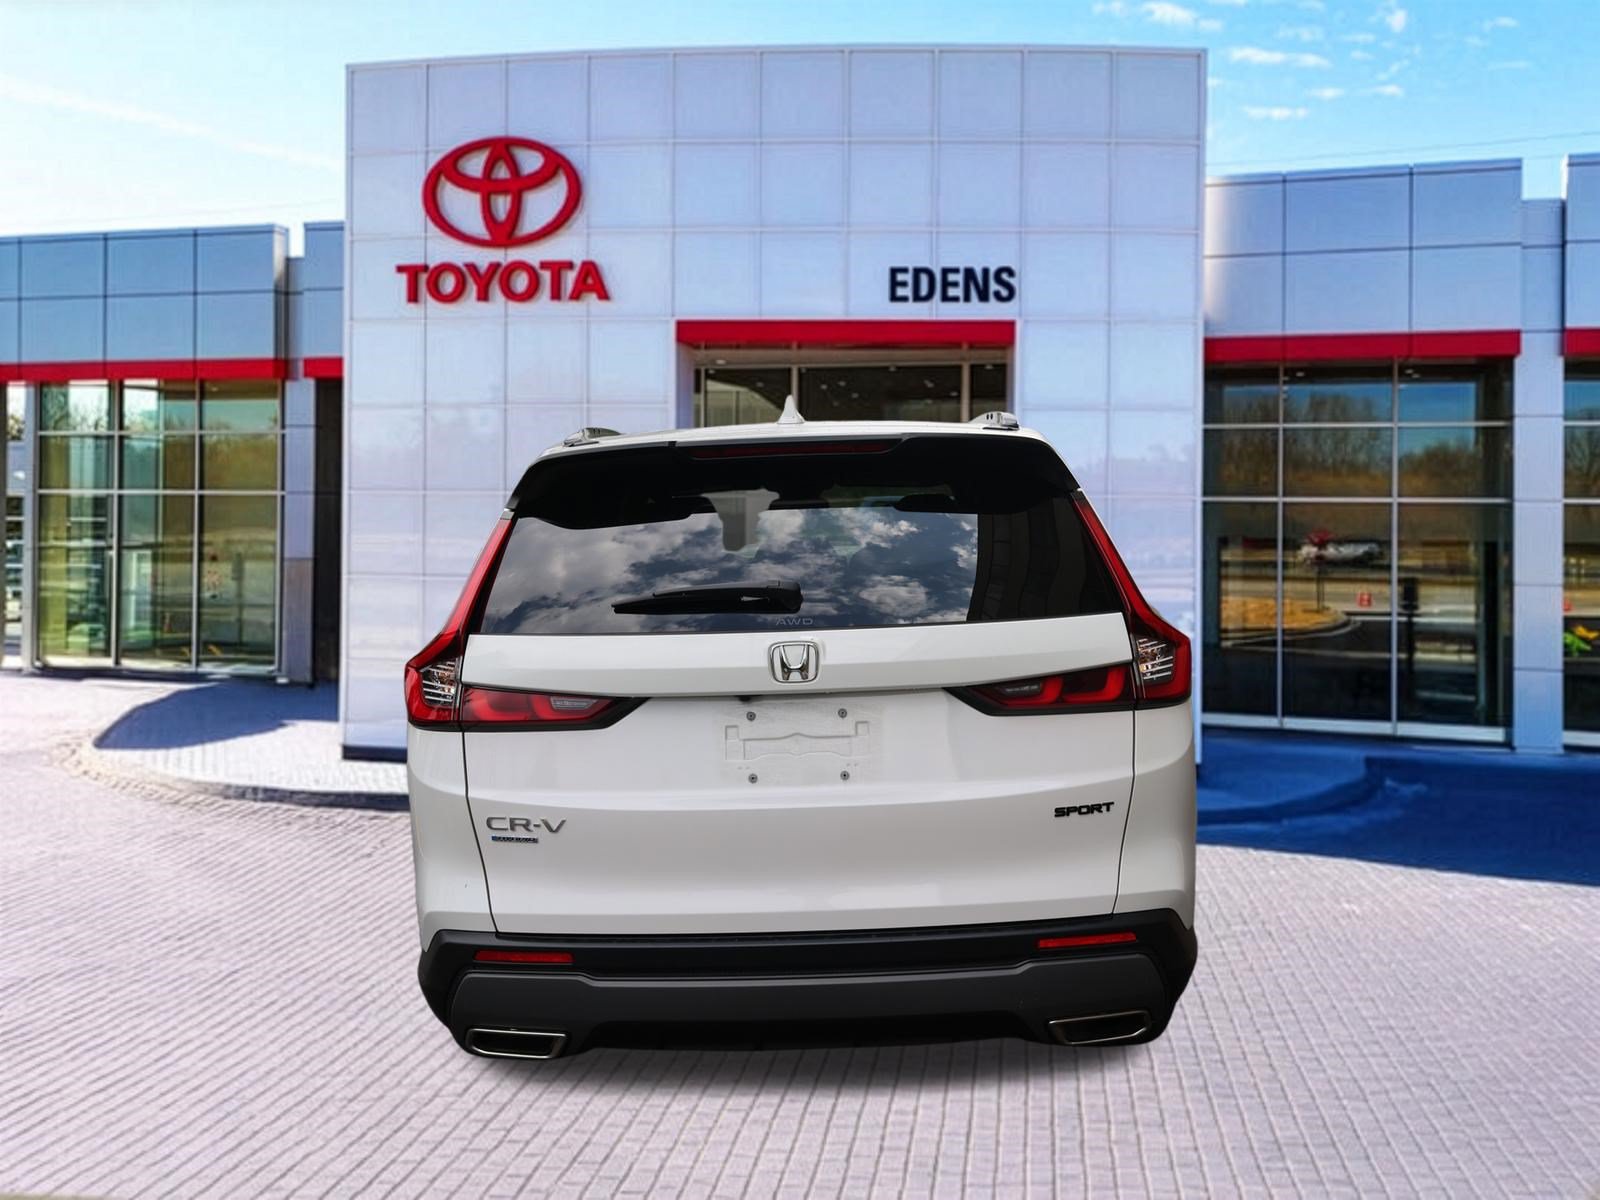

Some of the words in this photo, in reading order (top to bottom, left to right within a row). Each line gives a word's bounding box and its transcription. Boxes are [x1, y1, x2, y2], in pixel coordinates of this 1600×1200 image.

[395, 260, 611, 304] TOYOTA
[889, 266, 1017, 303] EDENS
[775, 616, 814, 626] AWD
[1054, 801, 1115, 818] SPORT
[485, 816, 567, 834] CR-V
